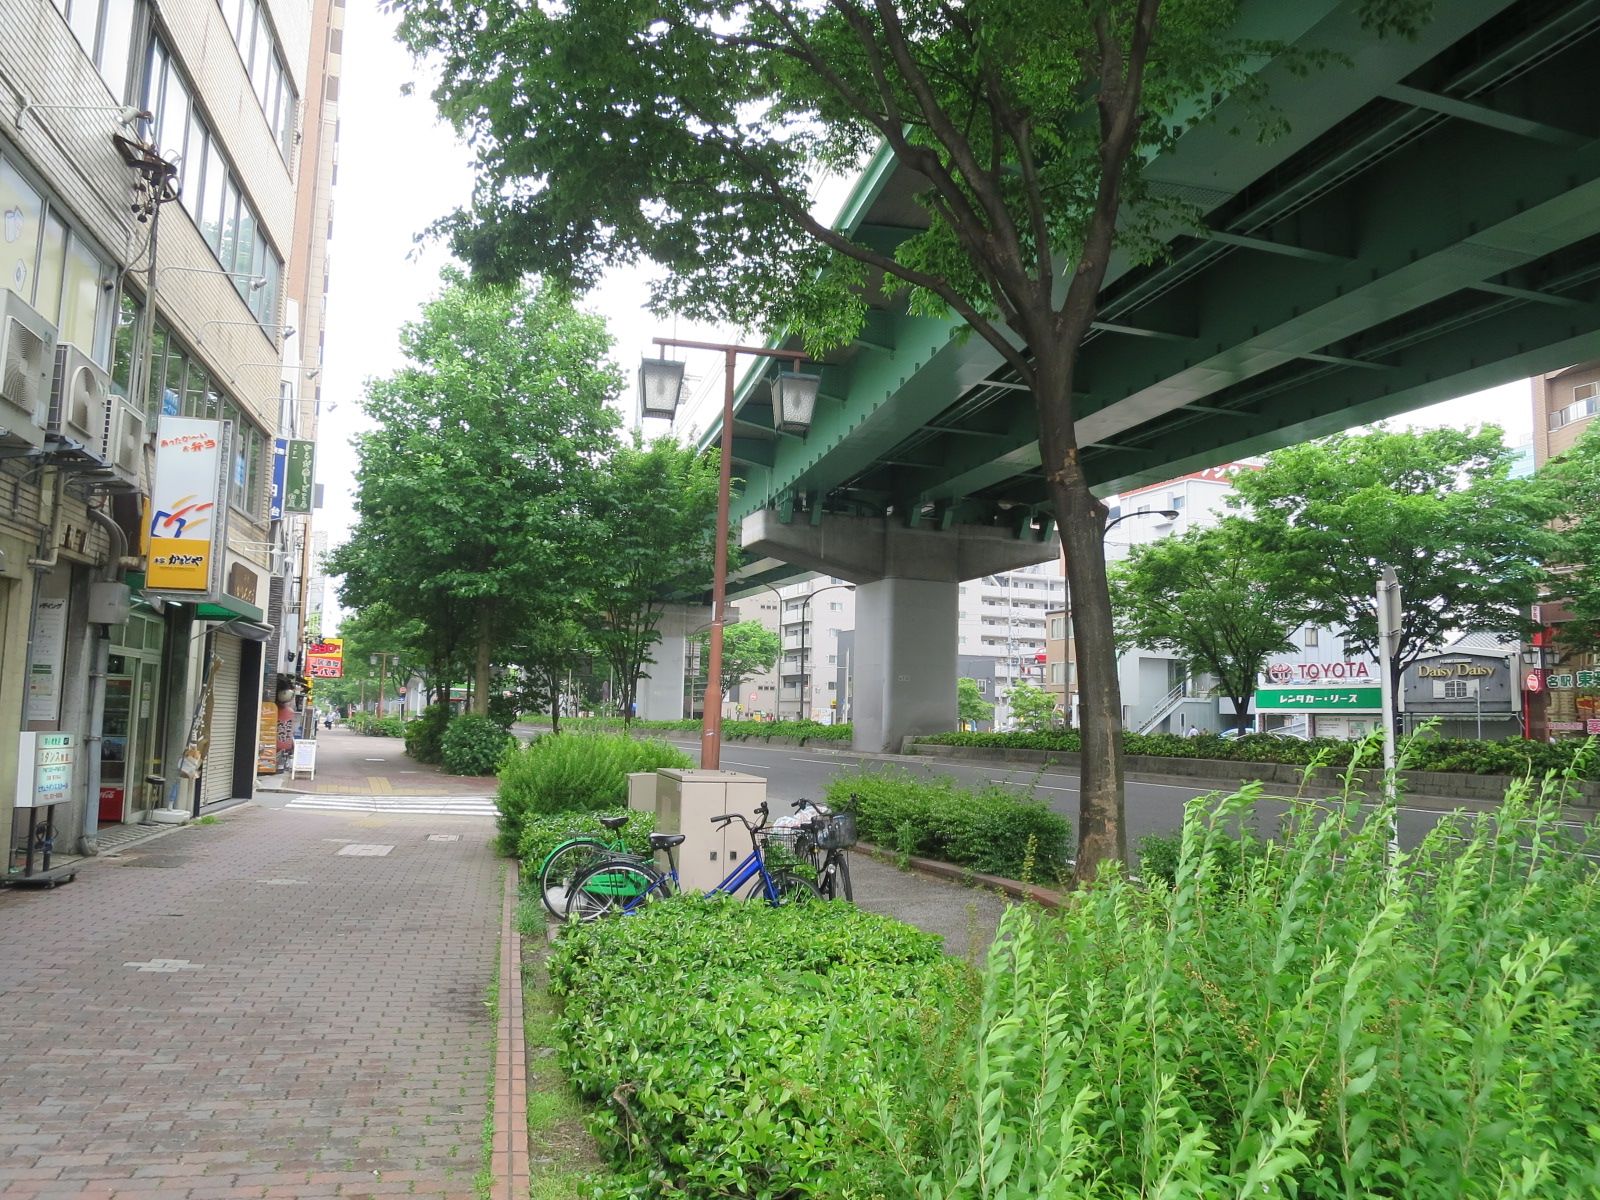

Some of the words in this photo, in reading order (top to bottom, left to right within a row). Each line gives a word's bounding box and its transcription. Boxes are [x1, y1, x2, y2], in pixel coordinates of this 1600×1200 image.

[1298, 662, 1369, 679] TOYOTA
[1418, 665, 1454, 679] Daisy
[1456, 663, 1495, 678] Daisy
[1546, 674, 1573, 689] 名駅
[1279, 694, 1357, 704] レンタカー・リース
